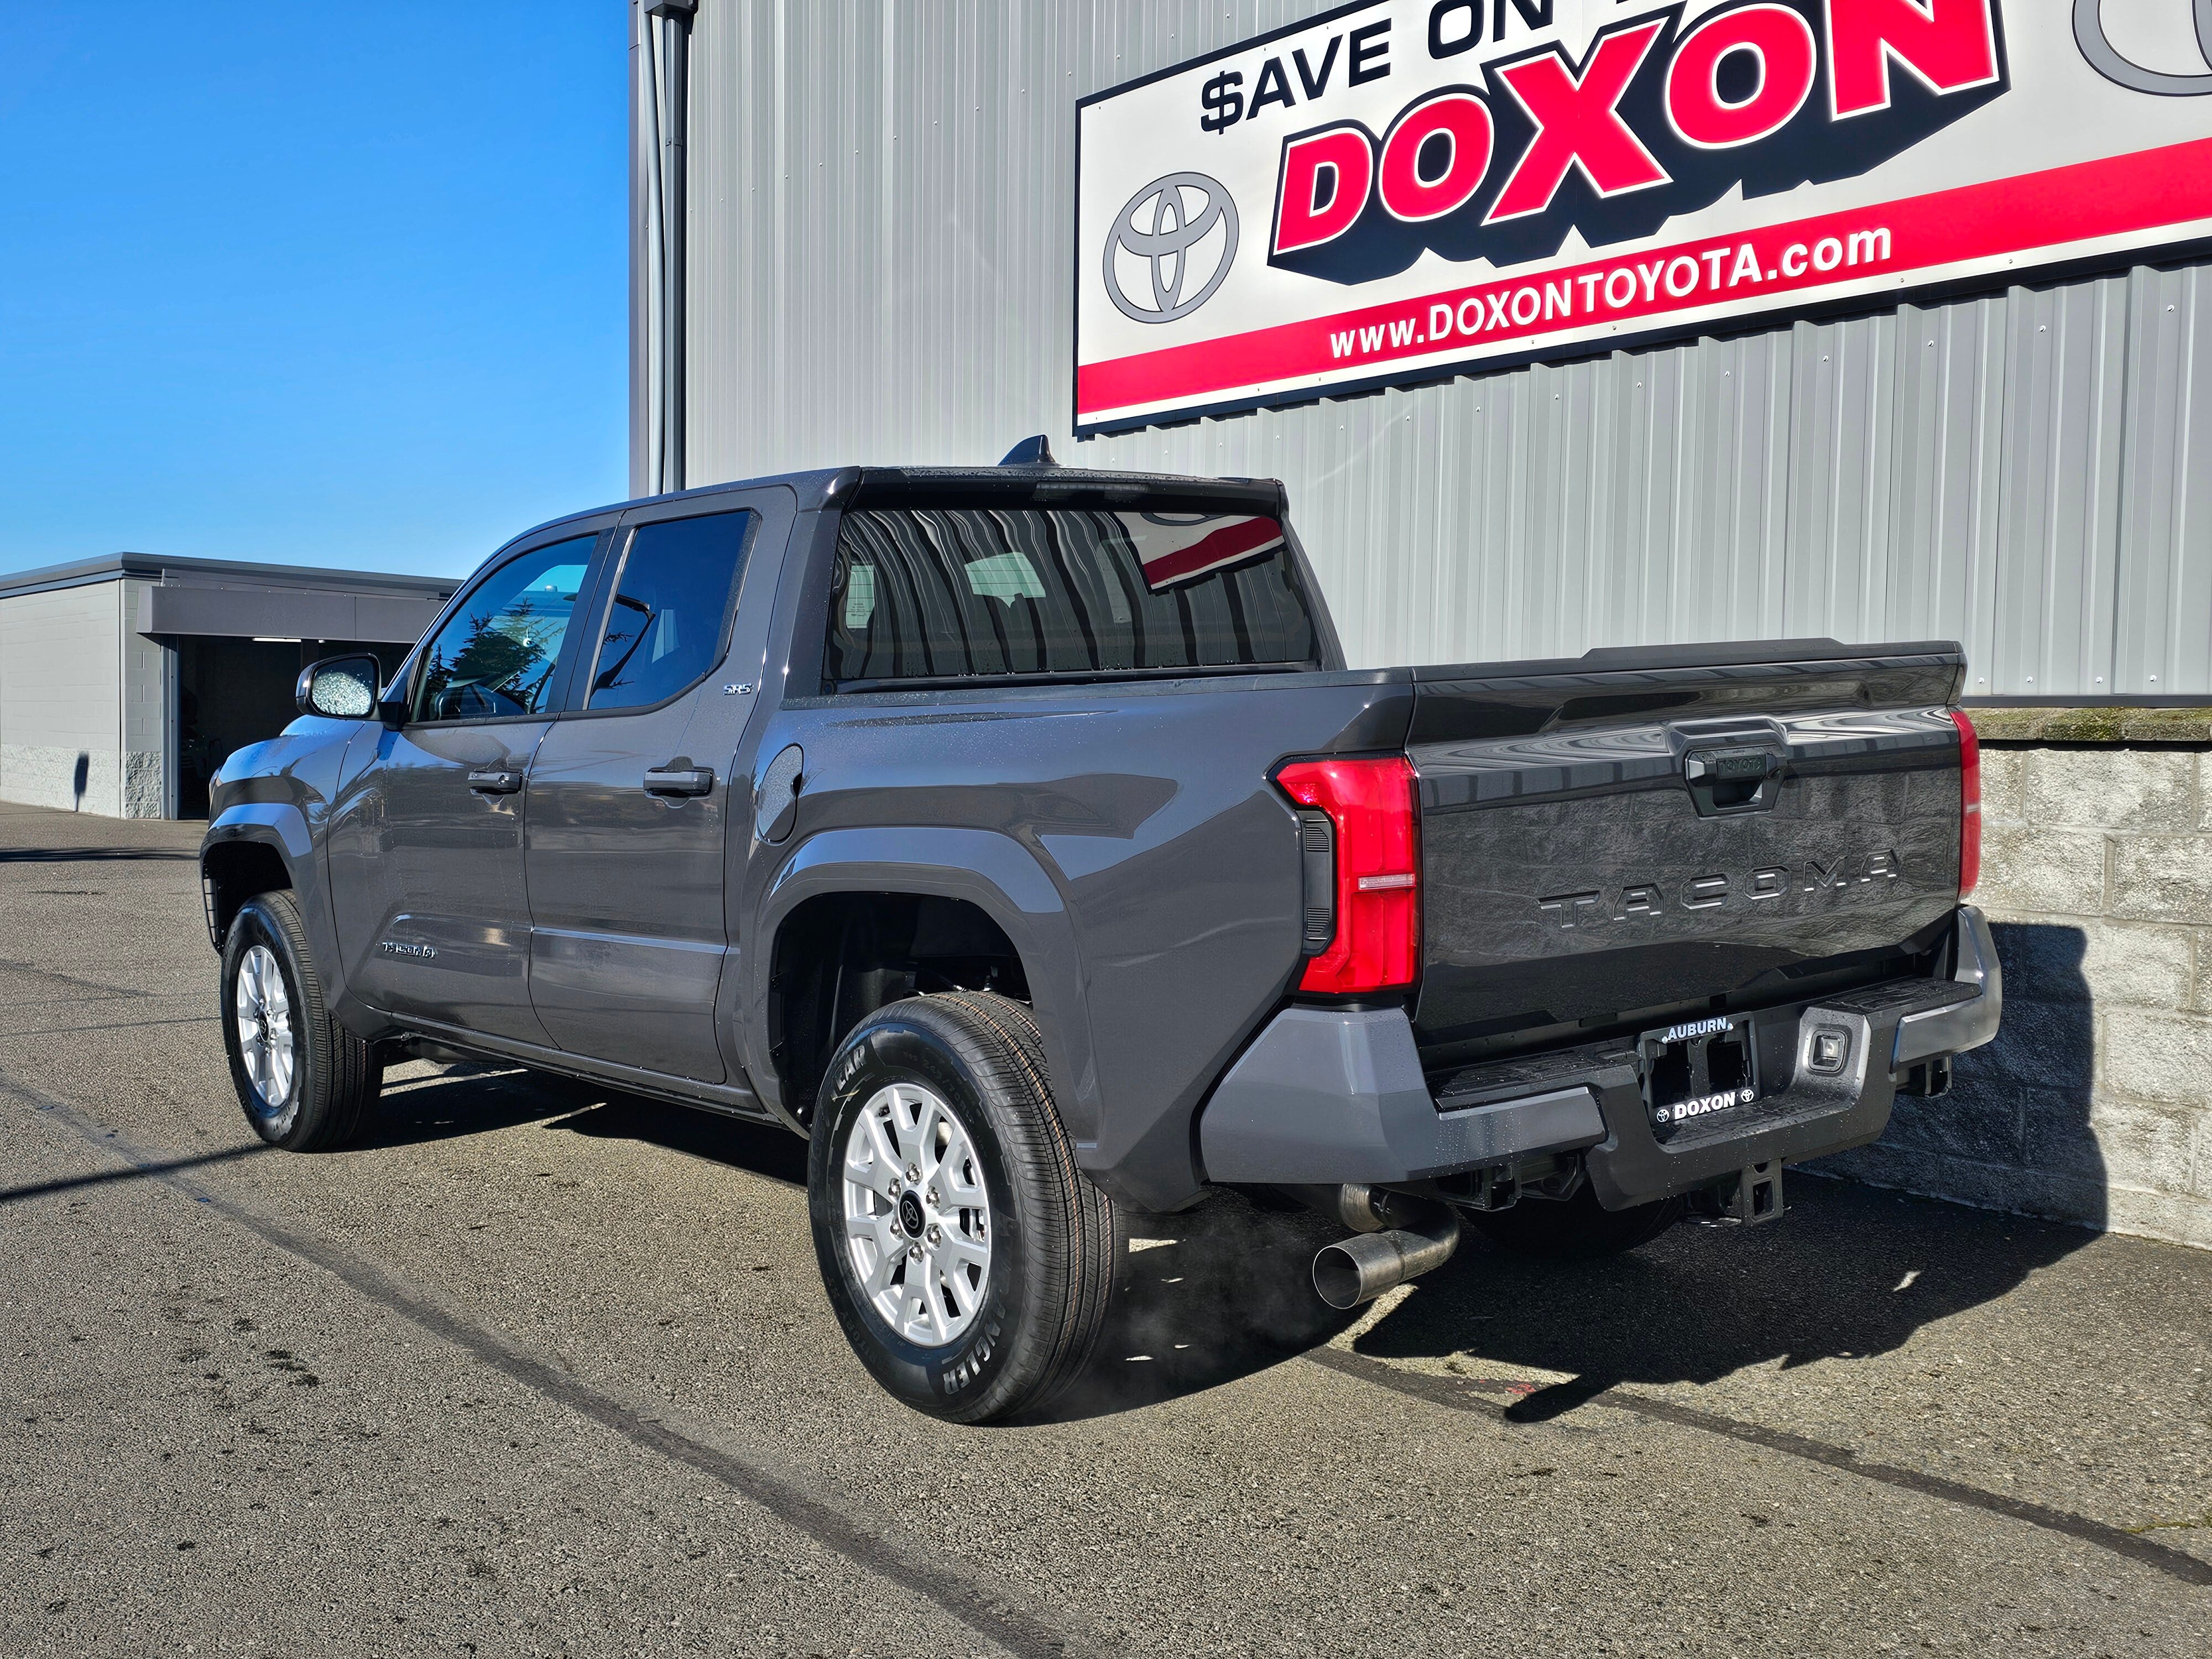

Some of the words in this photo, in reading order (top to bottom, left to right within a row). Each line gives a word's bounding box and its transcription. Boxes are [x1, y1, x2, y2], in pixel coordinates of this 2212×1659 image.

[1201, 18, 1391, 134] $AVE
[1428, 0, 1553, 59] ON
[1273, 0, 2000, 255] DOXON
[1331, 227, 1892, 358] www.DOXONTOYOTA.com
[1537, 848, 1899, 928] TACOMA
[1668, 1018, 1727, 1041] AUBURN
[1674, 1092, 1736, 1120] DOXON
